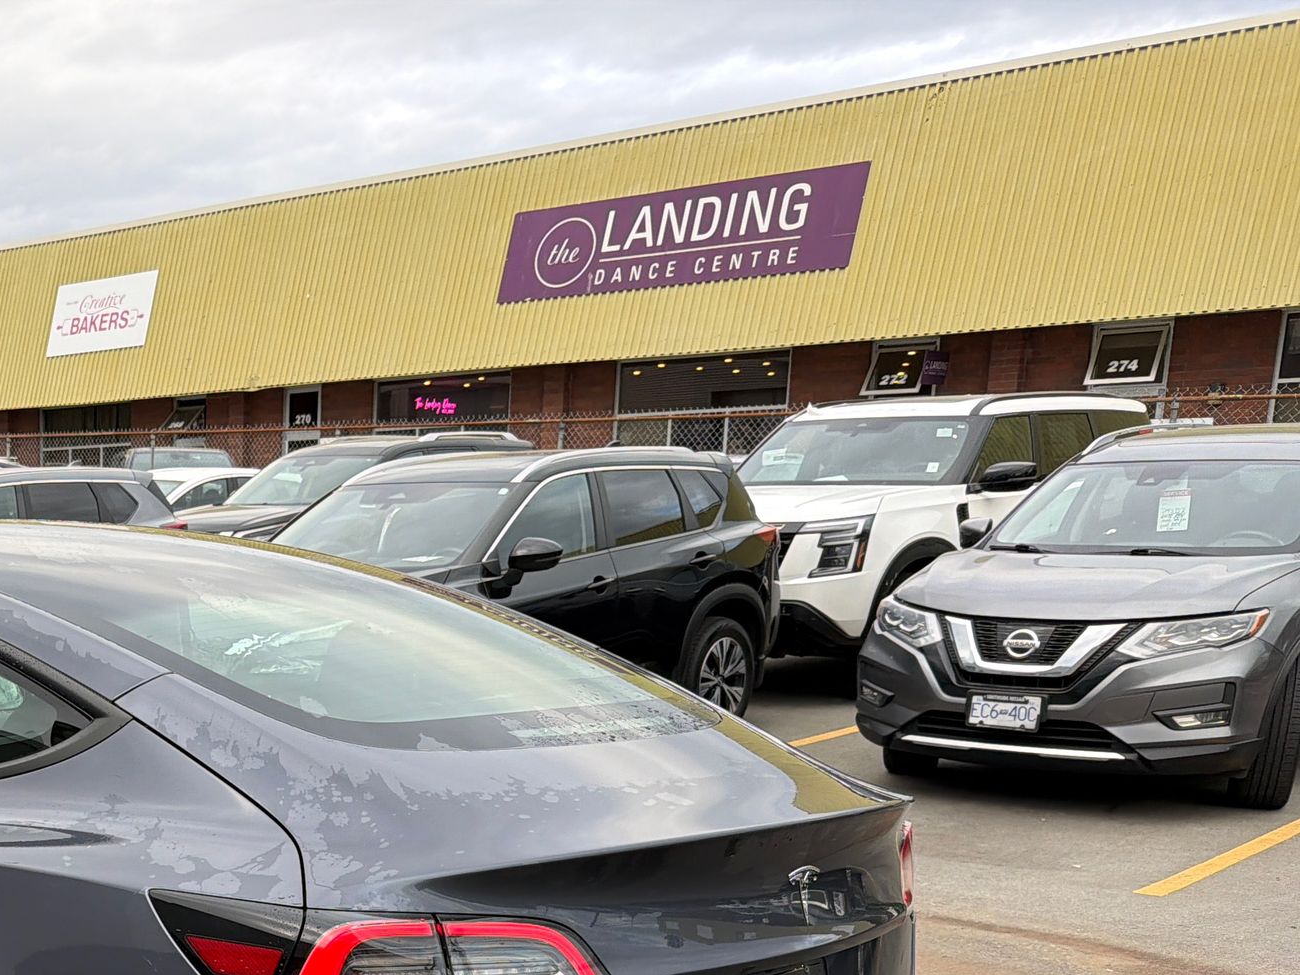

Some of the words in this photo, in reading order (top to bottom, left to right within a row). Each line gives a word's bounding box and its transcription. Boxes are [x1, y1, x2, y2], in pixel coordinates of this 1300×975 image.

[547, 238, 580, 267] the
[600, 182, 812, 253] LANDING
[593, 260, 677, 286] DANCE
[693, 246, 800, 275] CENTRE
[80, 292, 126, 313] Creative
[70, 310, 130, 335] BAKERS
[1106, 359, 1139, 373] 274
[878, 374, 908, 386] 272
[295, 414, 312, 425] 270
[1006, 640, 1036, 648] NISSAN
